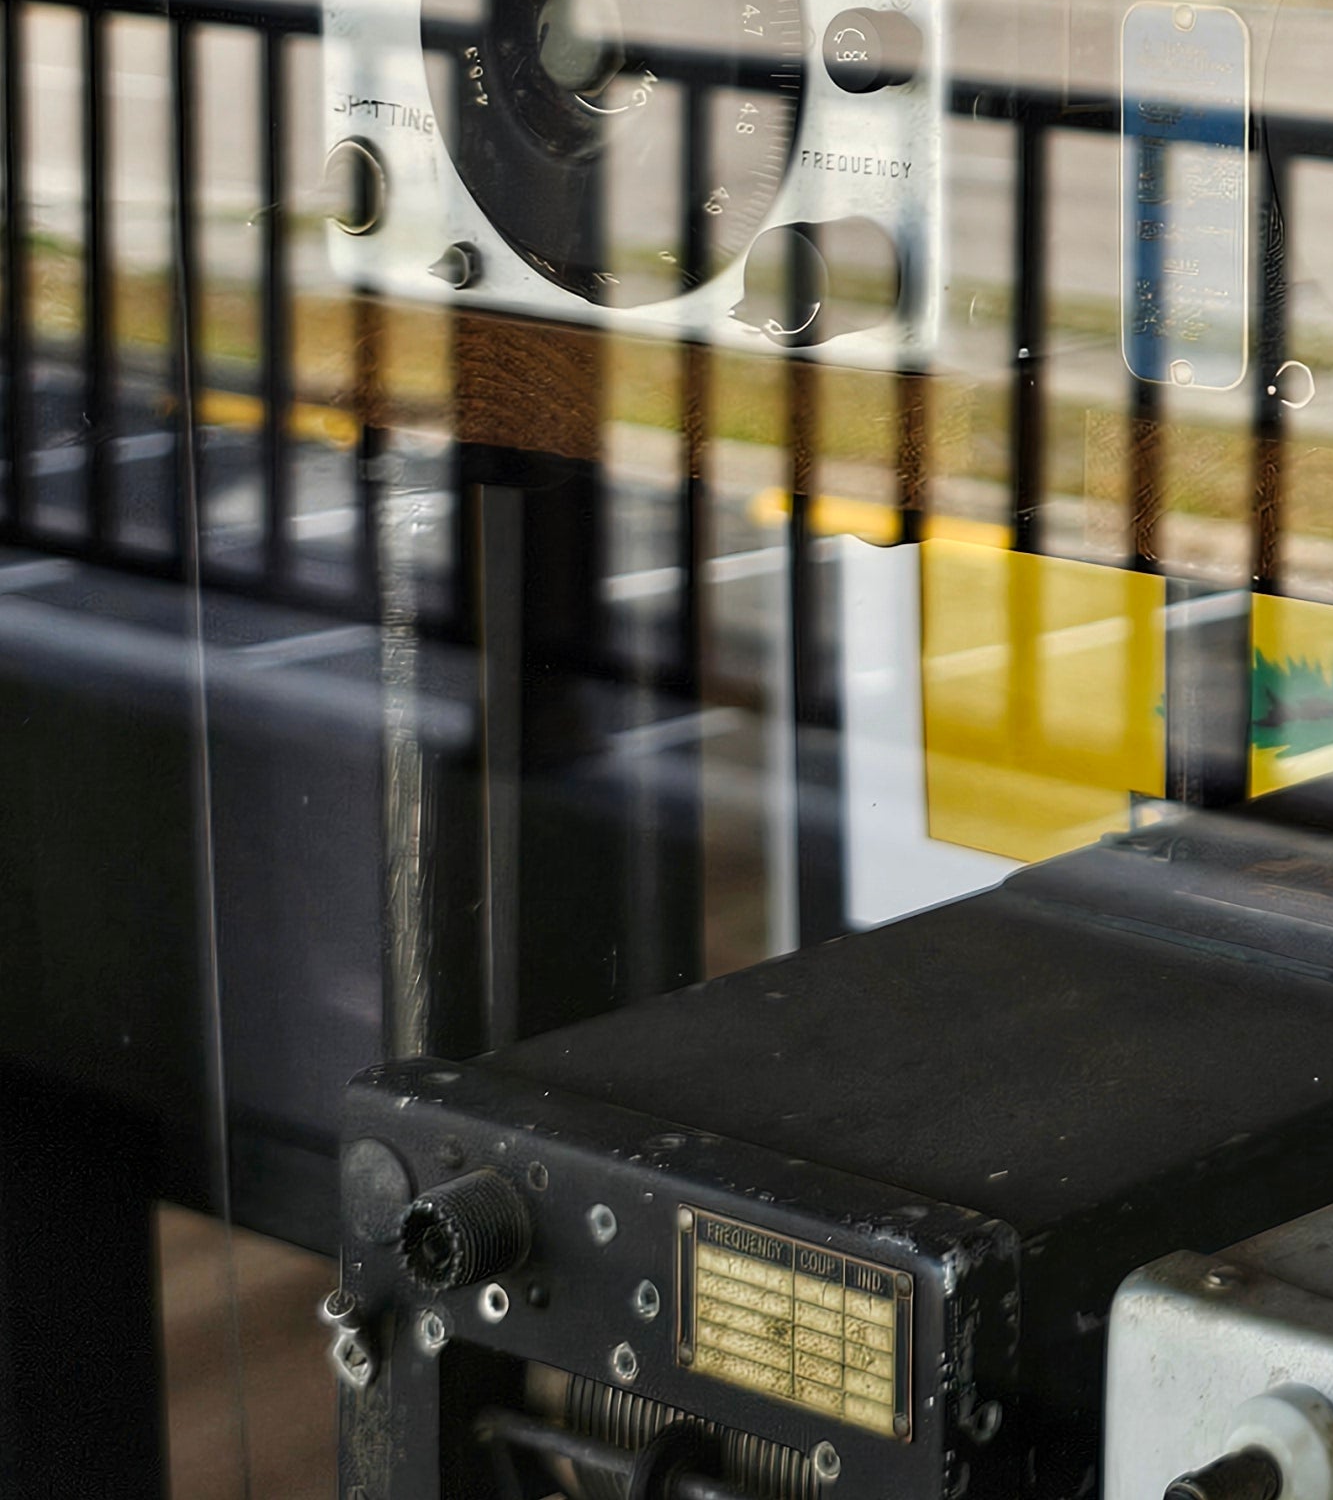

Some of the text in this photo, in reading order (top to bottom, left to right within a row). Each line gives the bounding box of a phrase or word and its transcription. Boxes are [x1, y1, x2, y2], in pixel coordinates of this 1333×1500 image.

[742, 4, 763, 36] 4.7
[836, 51, 868, 62] LOCK
[801, 151, 912, 178] FREQUENCY
[708, 1222, 783, 1260] FREQUENCY
